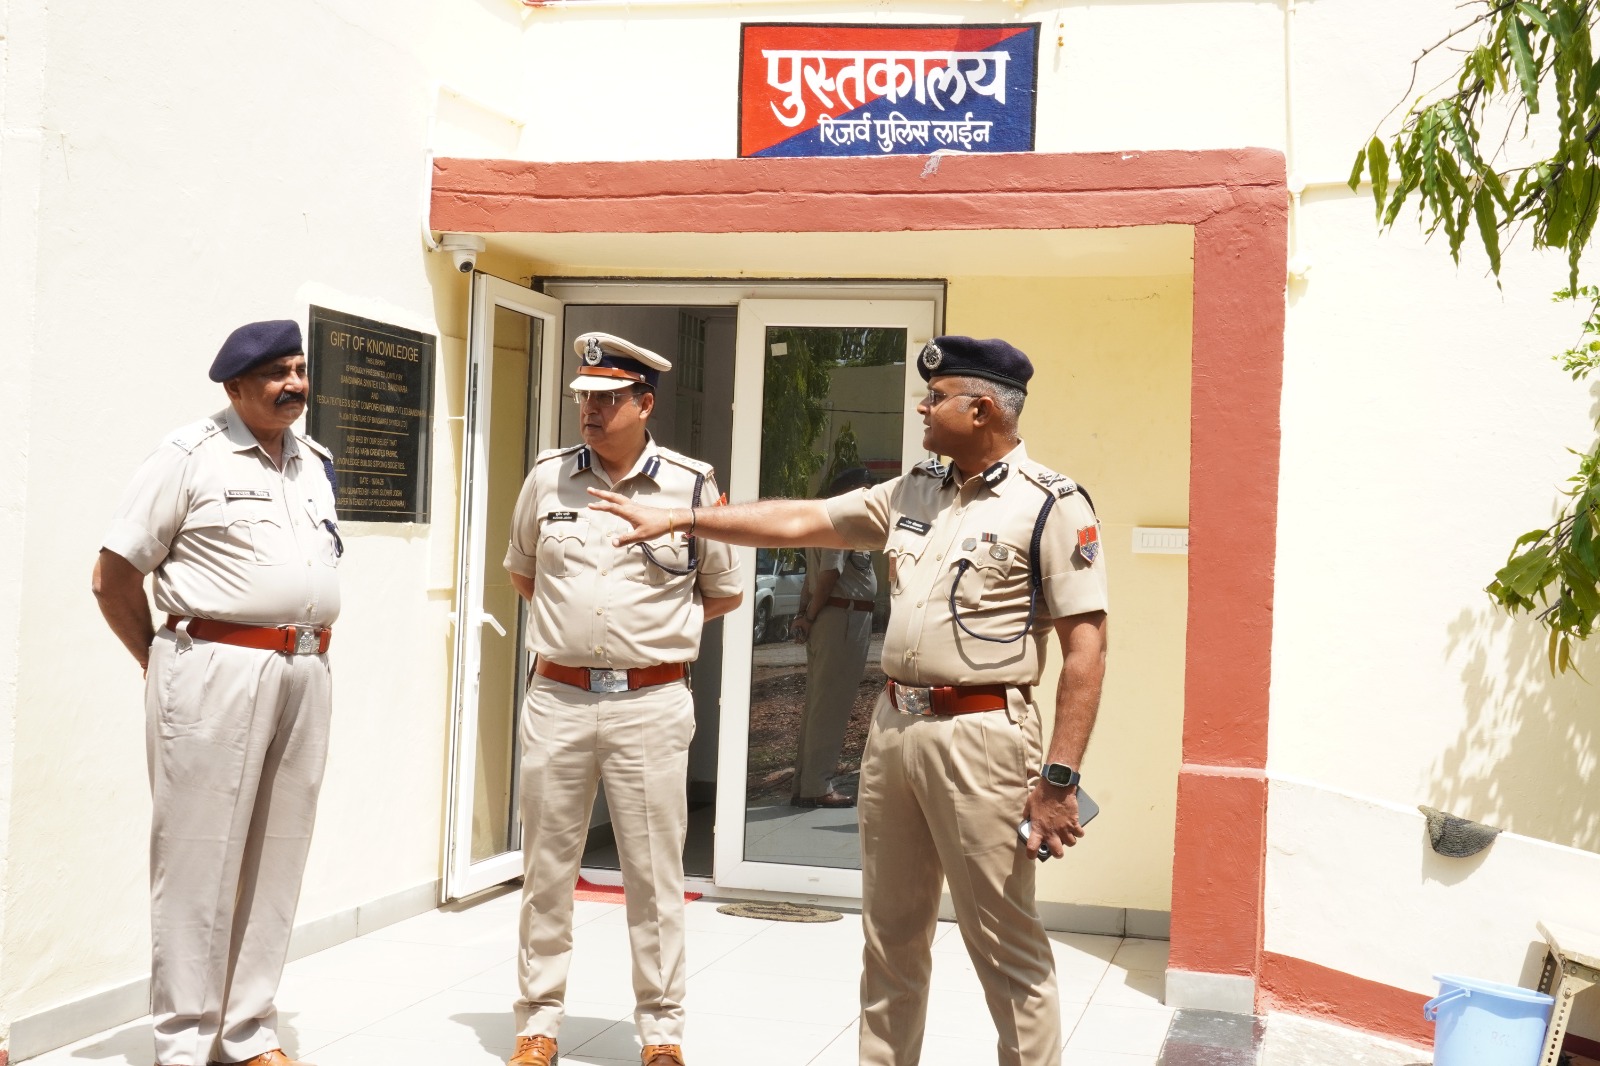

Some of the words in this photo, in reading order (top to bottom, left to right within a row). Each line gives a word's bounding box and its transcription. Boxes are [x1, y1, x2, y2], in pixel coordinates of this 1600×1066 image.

[761, 49, 1011, 127] पुस्तकालय
[873, 111, 932, 152] पुलिस
[932, 112, 993, 149] लाईन
[330, 330, 351, 349] GIFT
[353, 335, 365, 352] OF
[367, 338, 419, 363] KNOWLEDGE
[371, 392, 379, 401] AND
